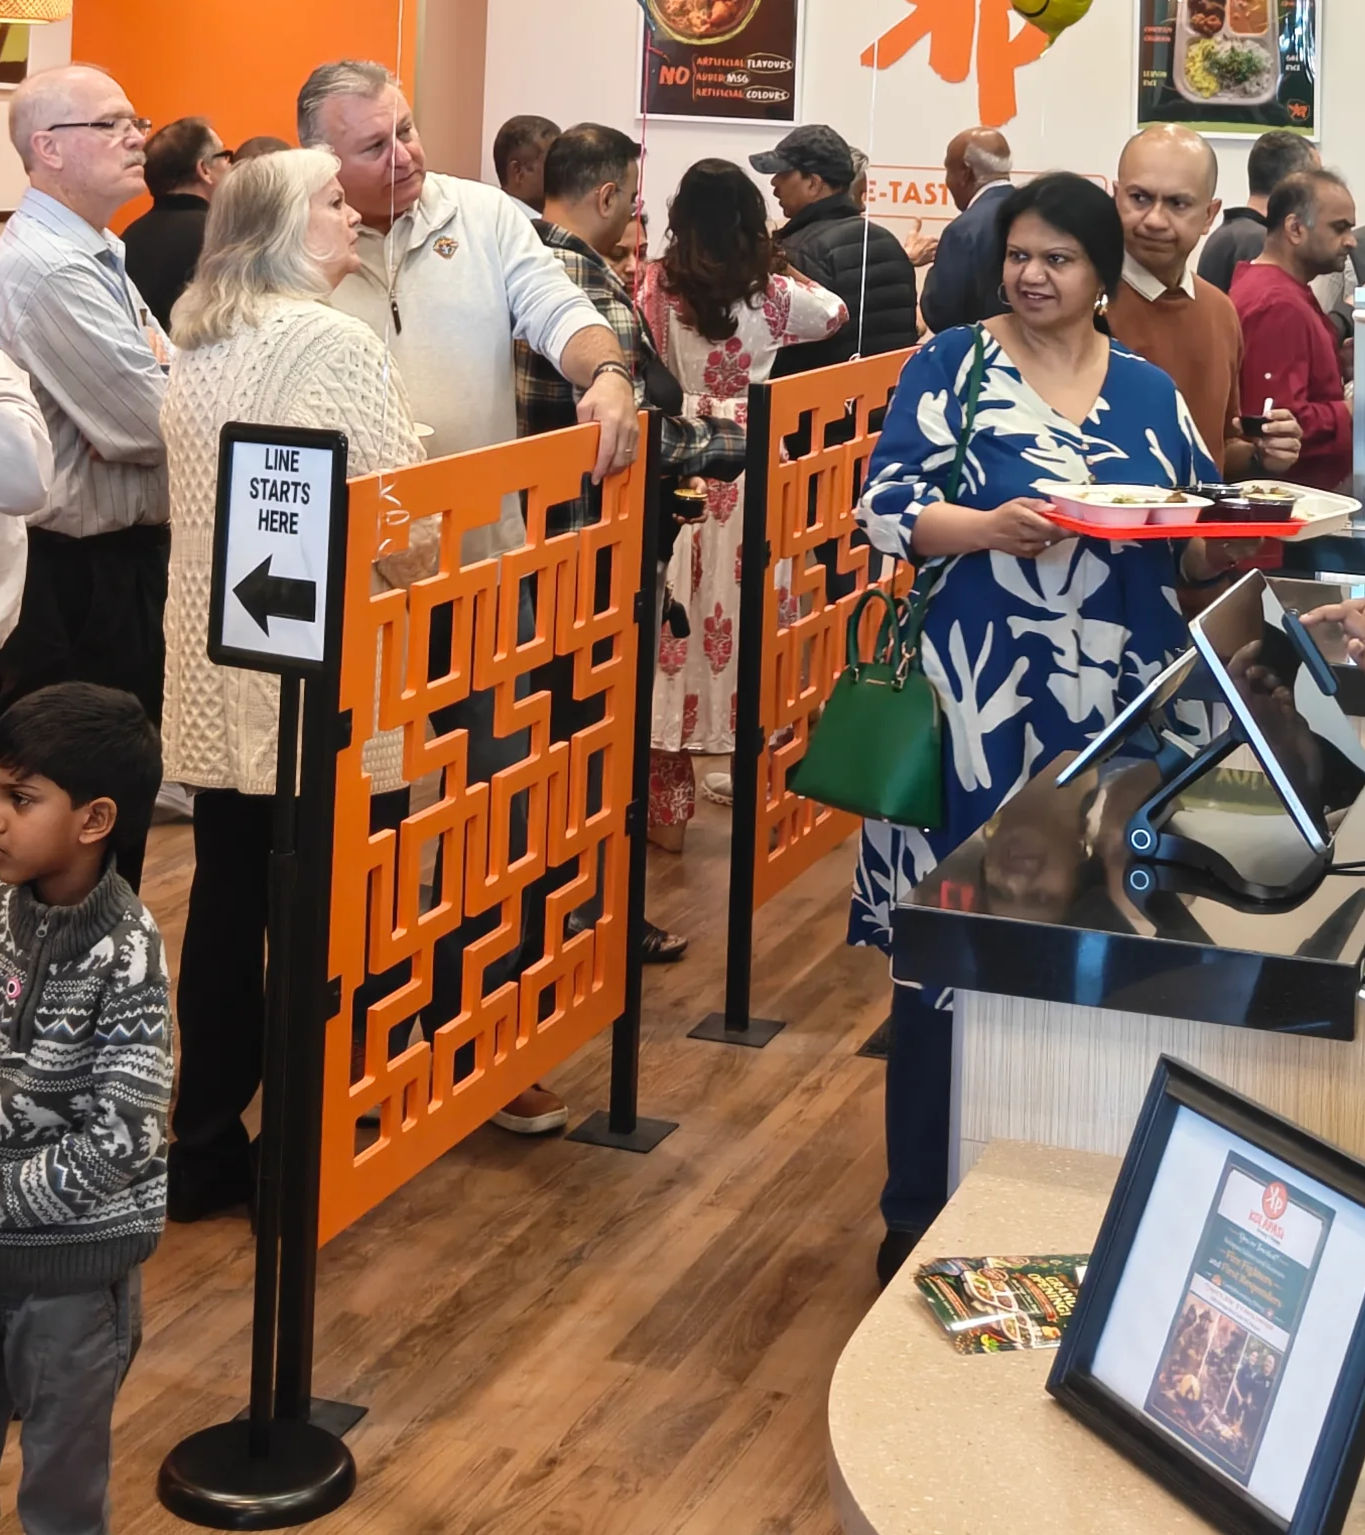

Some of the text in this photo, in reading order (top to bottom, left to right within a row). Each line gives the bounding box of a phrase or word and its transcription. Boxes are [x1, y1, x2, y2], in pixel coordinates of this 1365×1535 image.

[747, 58, 792, 70] FLAVOURS
[659, 65, 690, 85] NO
[726, 73, 749, 84] MSG
[746, 89, 786, 100] COLOURS
[265, 448, 300, 472] LINE
[249, 477, 311, 505] STARTS
[258, 508, 299, 535] HERE
